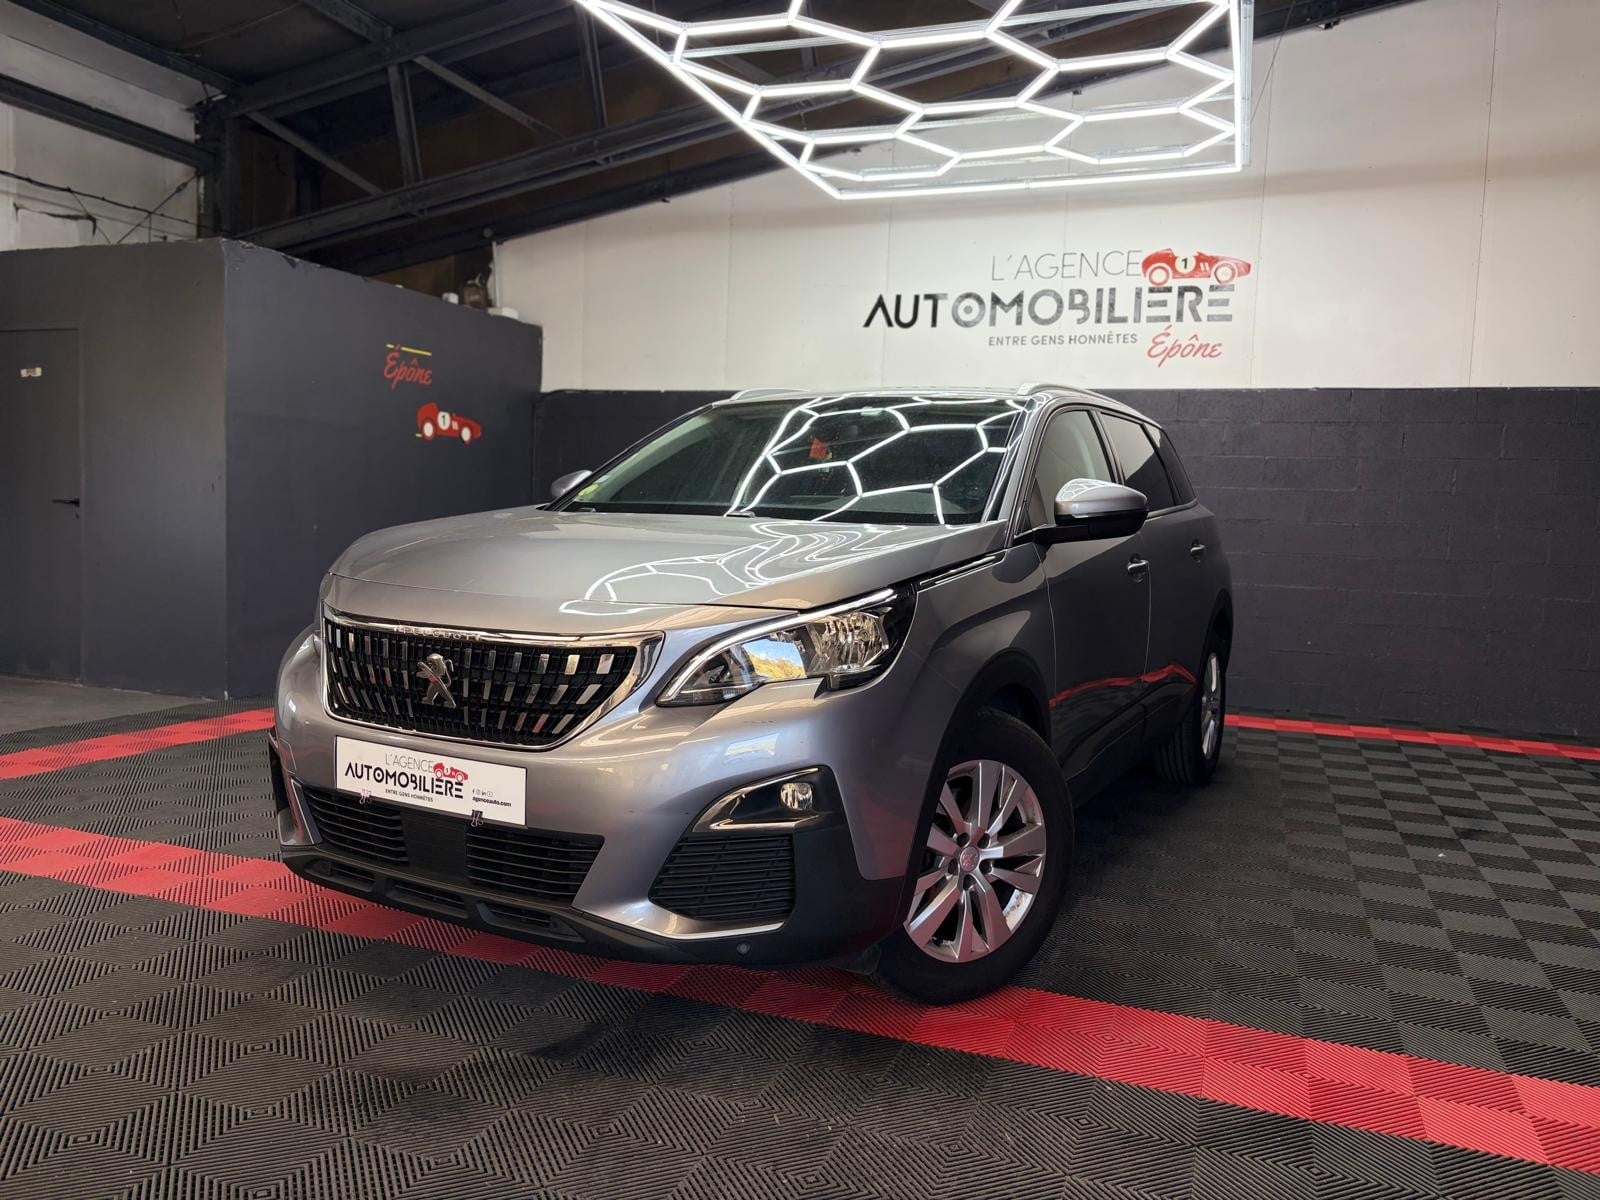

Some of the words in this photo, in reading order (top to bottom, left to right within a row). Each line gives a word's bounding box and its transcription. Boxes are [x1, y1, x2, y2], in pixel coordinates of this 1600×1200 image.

[992, 250, 1143, 281] L'AGENCE
[1181, 257, 1189, 270] 1
[988, 334, 1027, 347] ENTRE
[1031, 333, 1065, 346] GENS
[1068, 330, 1138, 345] HONNÊTES
[1146, 324, 1223, 368] Épône
[383, 344, 432, 390] Épône
[385, 753, 433, 774] L'AGENCE
